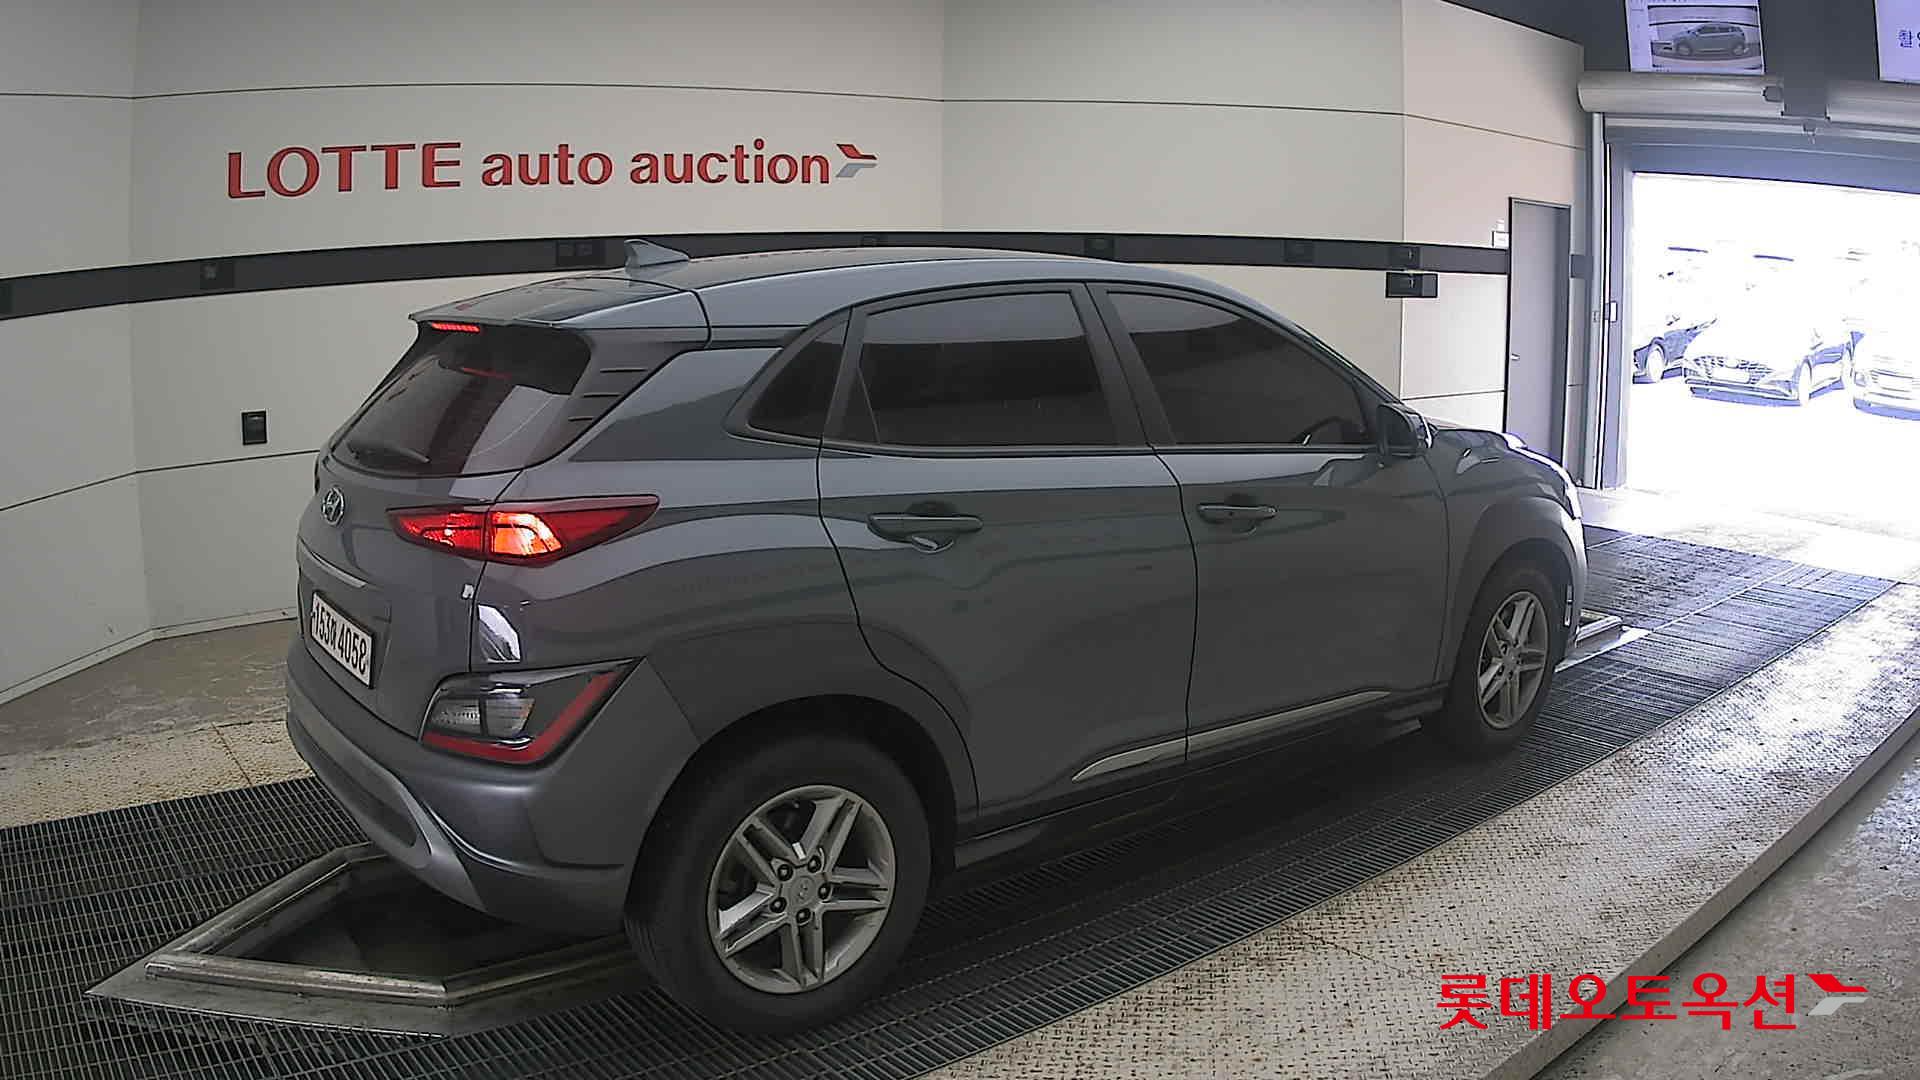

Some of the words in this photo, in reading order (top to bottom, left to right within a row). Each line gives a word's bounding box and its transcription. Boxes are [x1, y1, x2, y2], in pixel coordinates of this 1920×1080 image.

[228, 142, 461, 199] LOTTE
[481, 143, 613, 186] auto
[630, 139, 829, 185] auction
[338, 623, 367, 675] 4058
